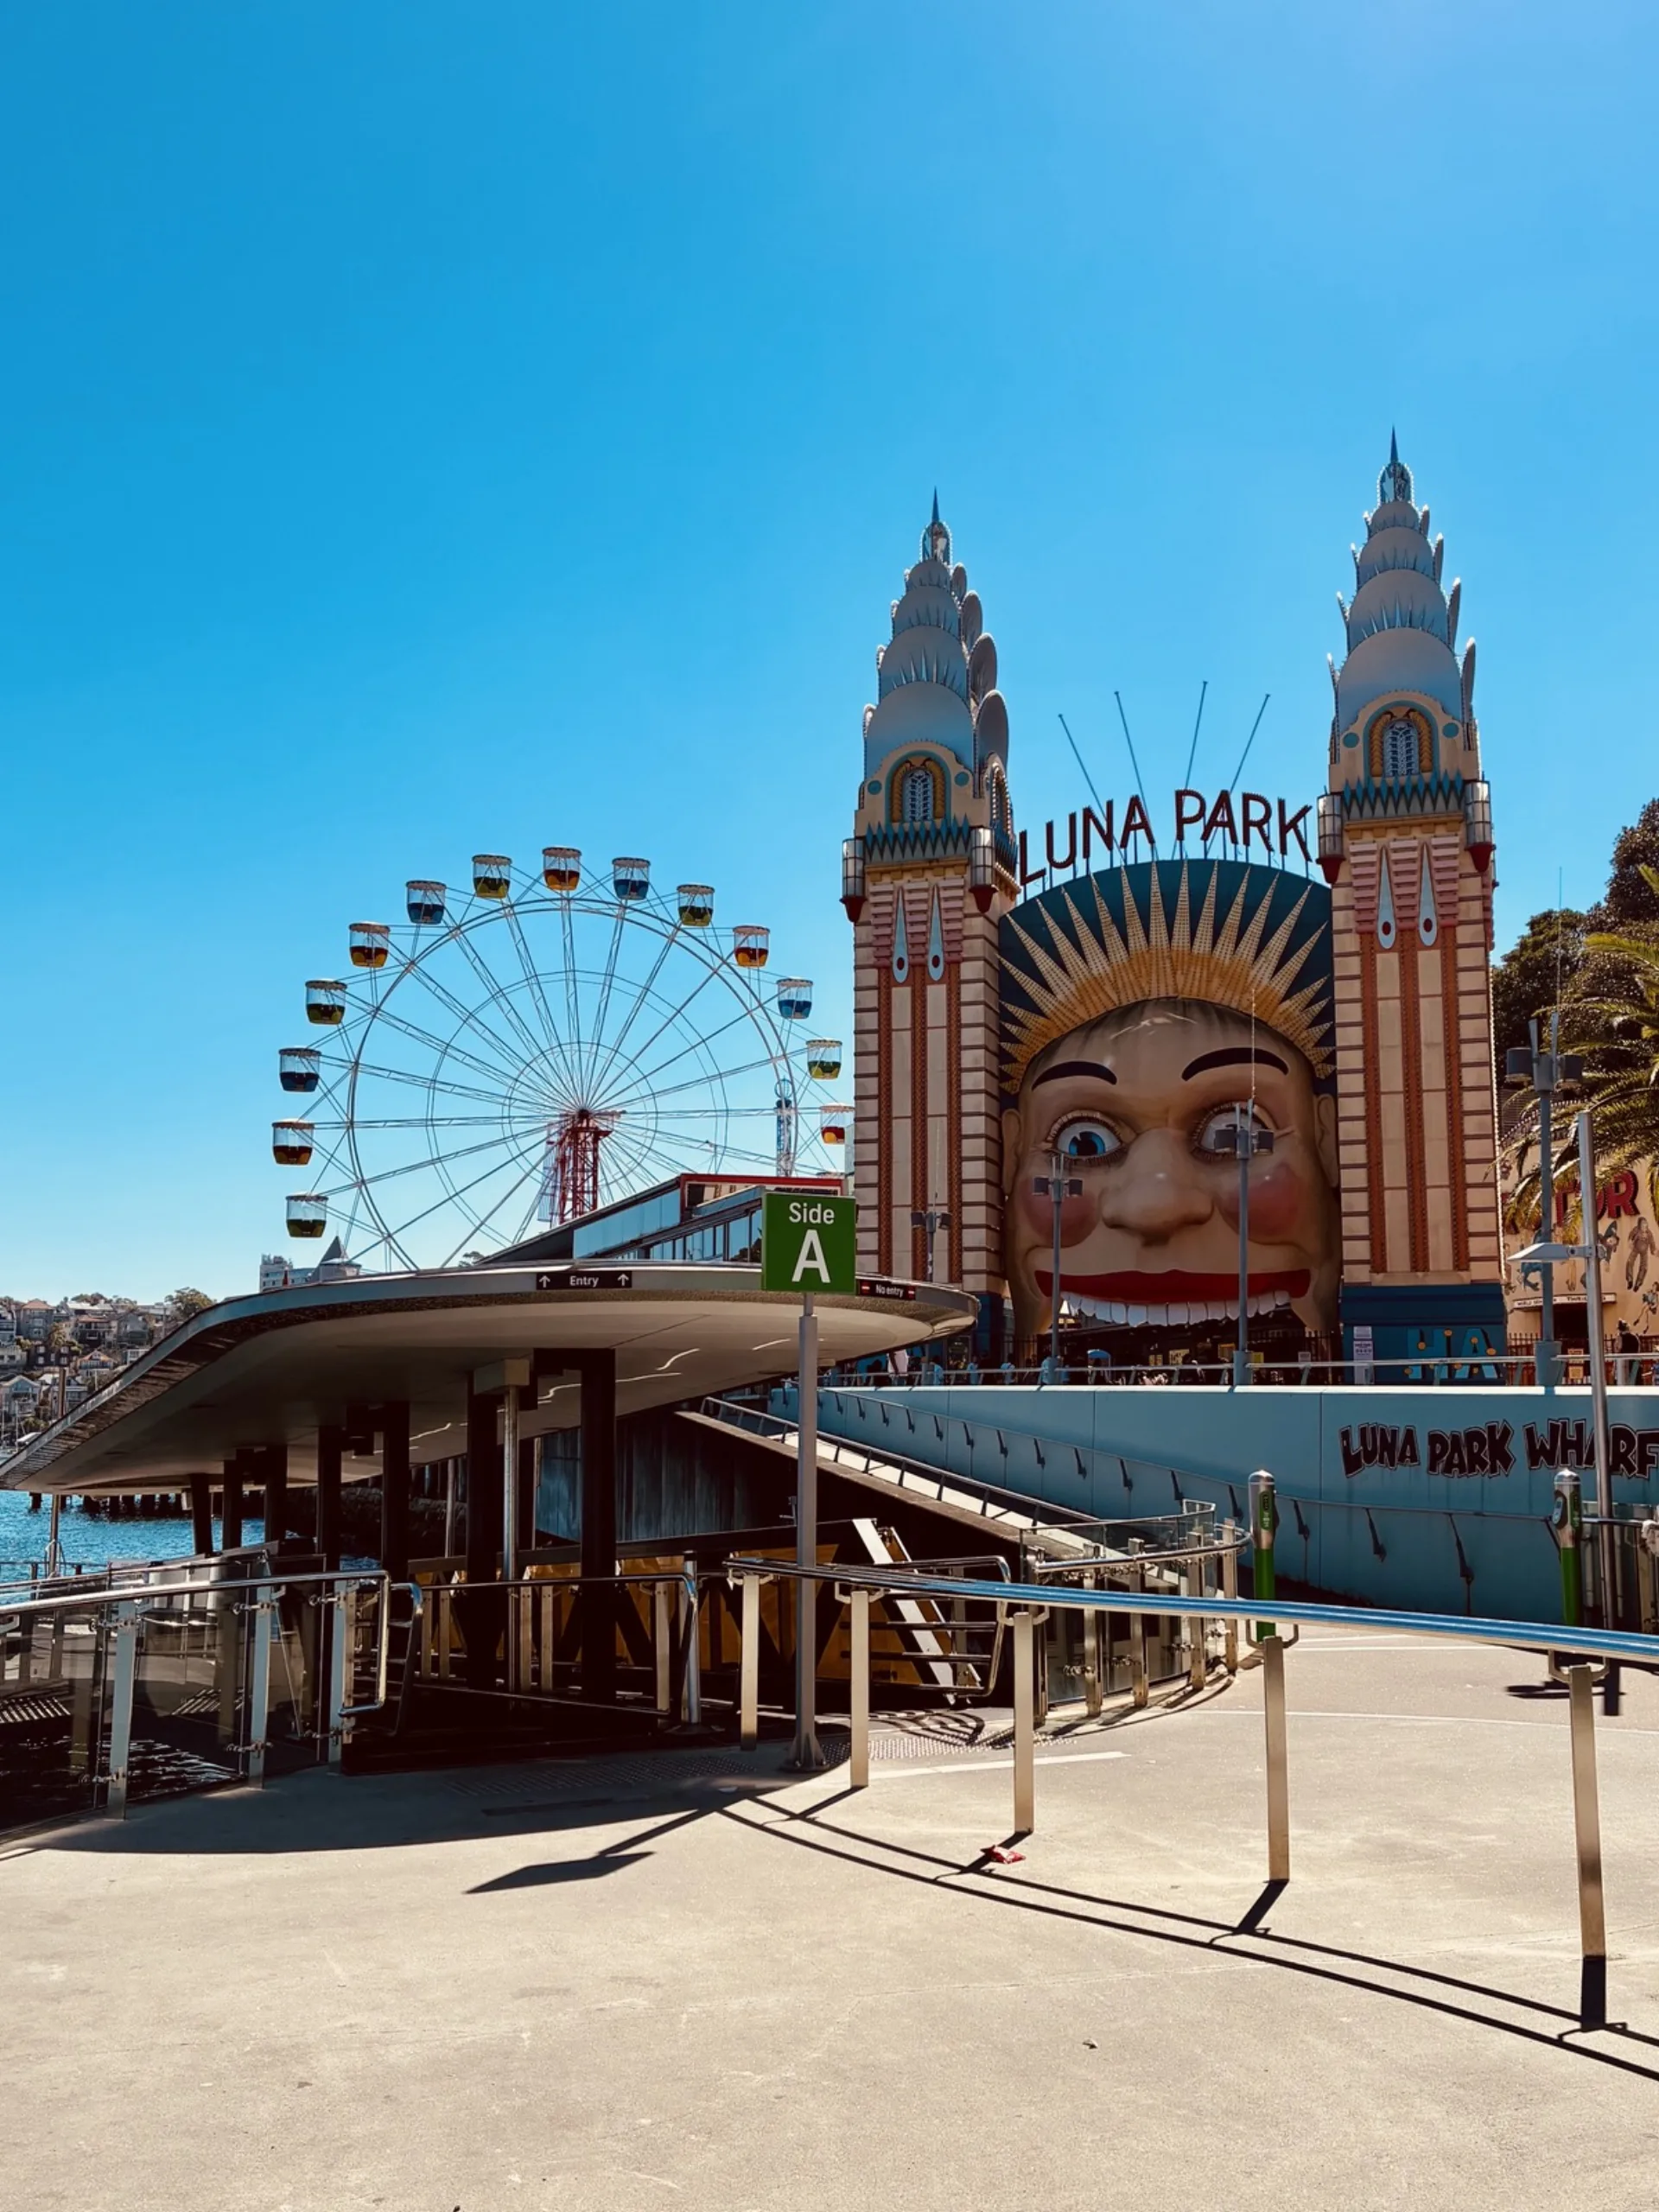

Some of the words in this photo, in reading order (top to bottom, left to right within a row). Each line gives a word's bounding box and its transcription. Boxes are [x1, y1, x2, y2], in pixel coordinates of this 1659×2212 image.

[1020, 795, 1155, 886] LUNA
[1175, 790, 1313, 862] PARK
[789, 1202, 835, 1224] Side
[791, 1229, 831, 1283] A
[569, 1275, 600, 1287] Entry
[875, 1284, 886, 1294] No
[887, 1286, 904, 1298] entry
[1339, 1423, 1421, 1478] LUNA
[1427, 1420, 1516, 1478] PARK
